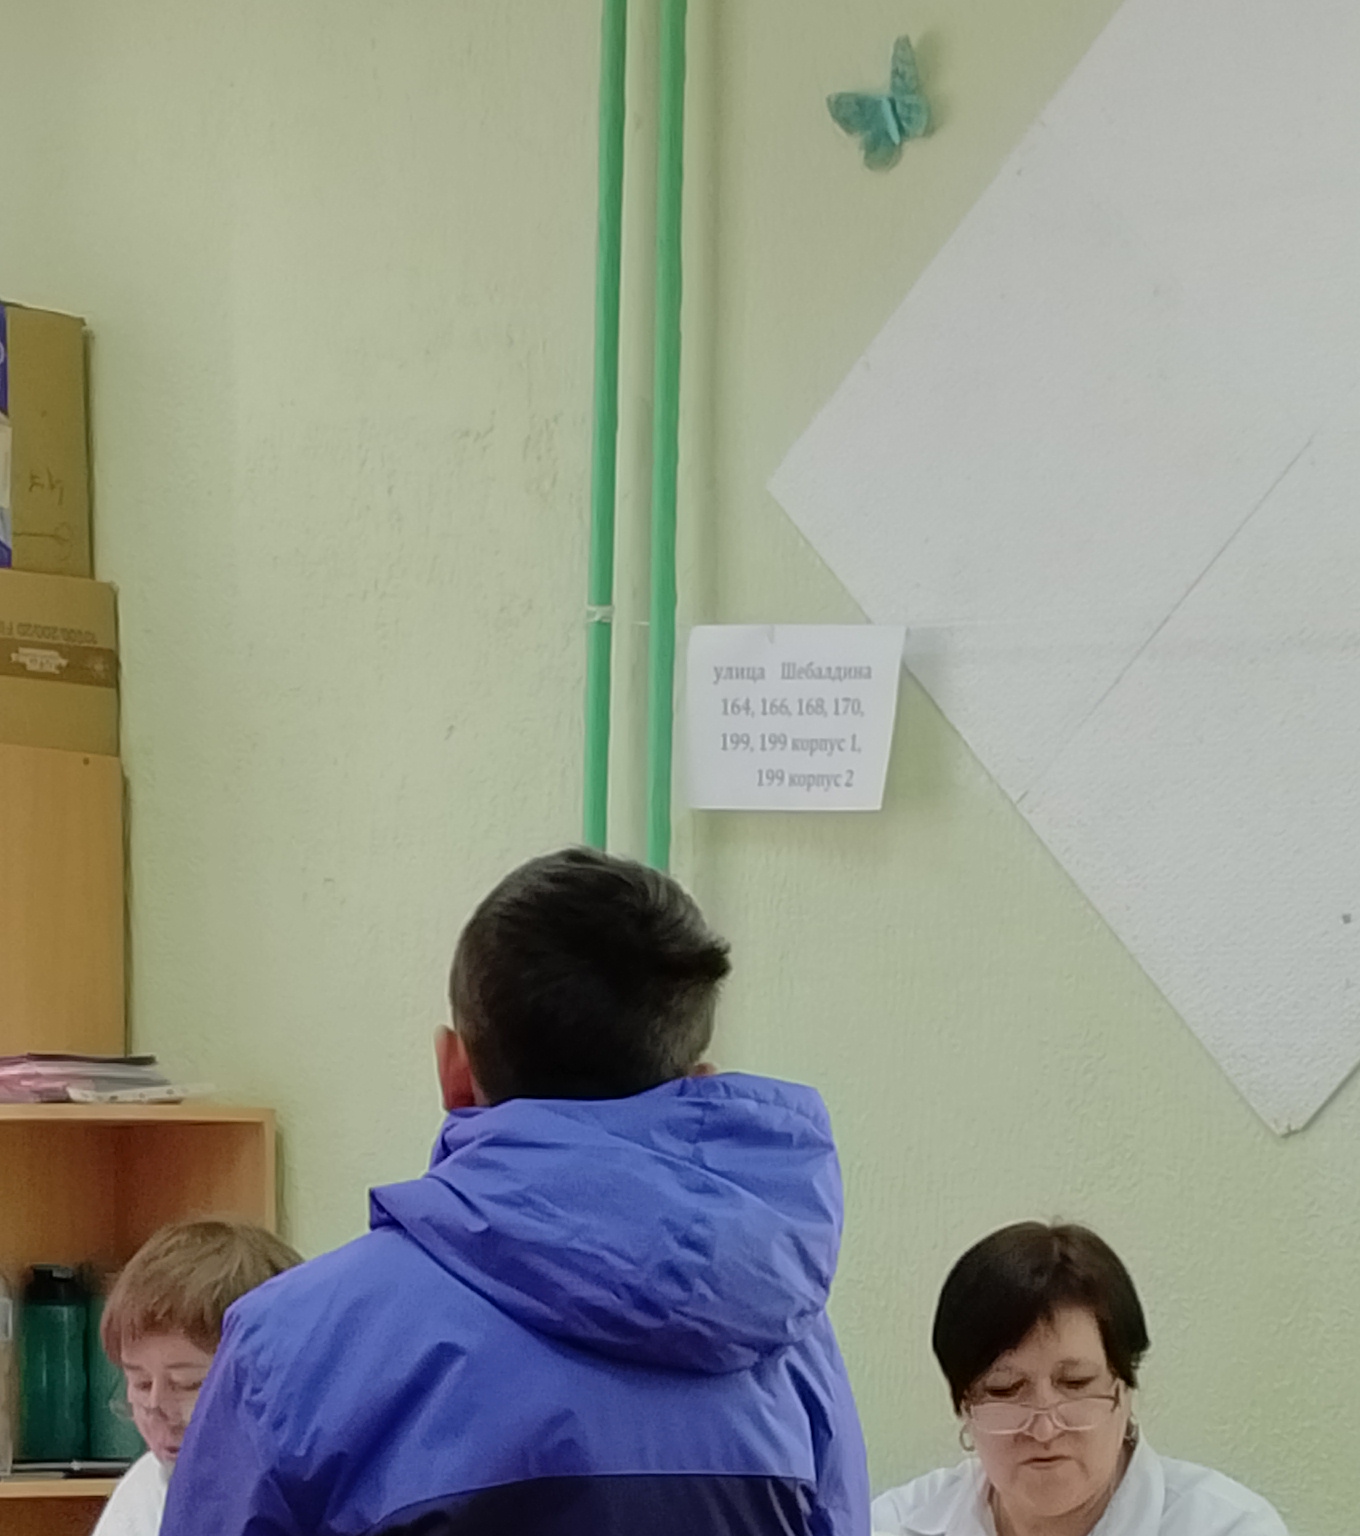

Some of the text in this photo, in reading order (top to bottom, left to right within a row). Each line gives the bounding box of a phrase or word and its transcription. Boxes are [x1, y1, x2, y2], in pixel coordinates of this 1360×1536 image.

[713, 662, 873, 686] улица Шебалдина
[722, 698, 865, 718] 164, 166, 168, 170,
[720, 733, 755, 753] 199,
[759, 732, 788, 752] 199
[791, 738, 846, 757] корпус
[757, 769, 855, 792] 199 корпус 2
